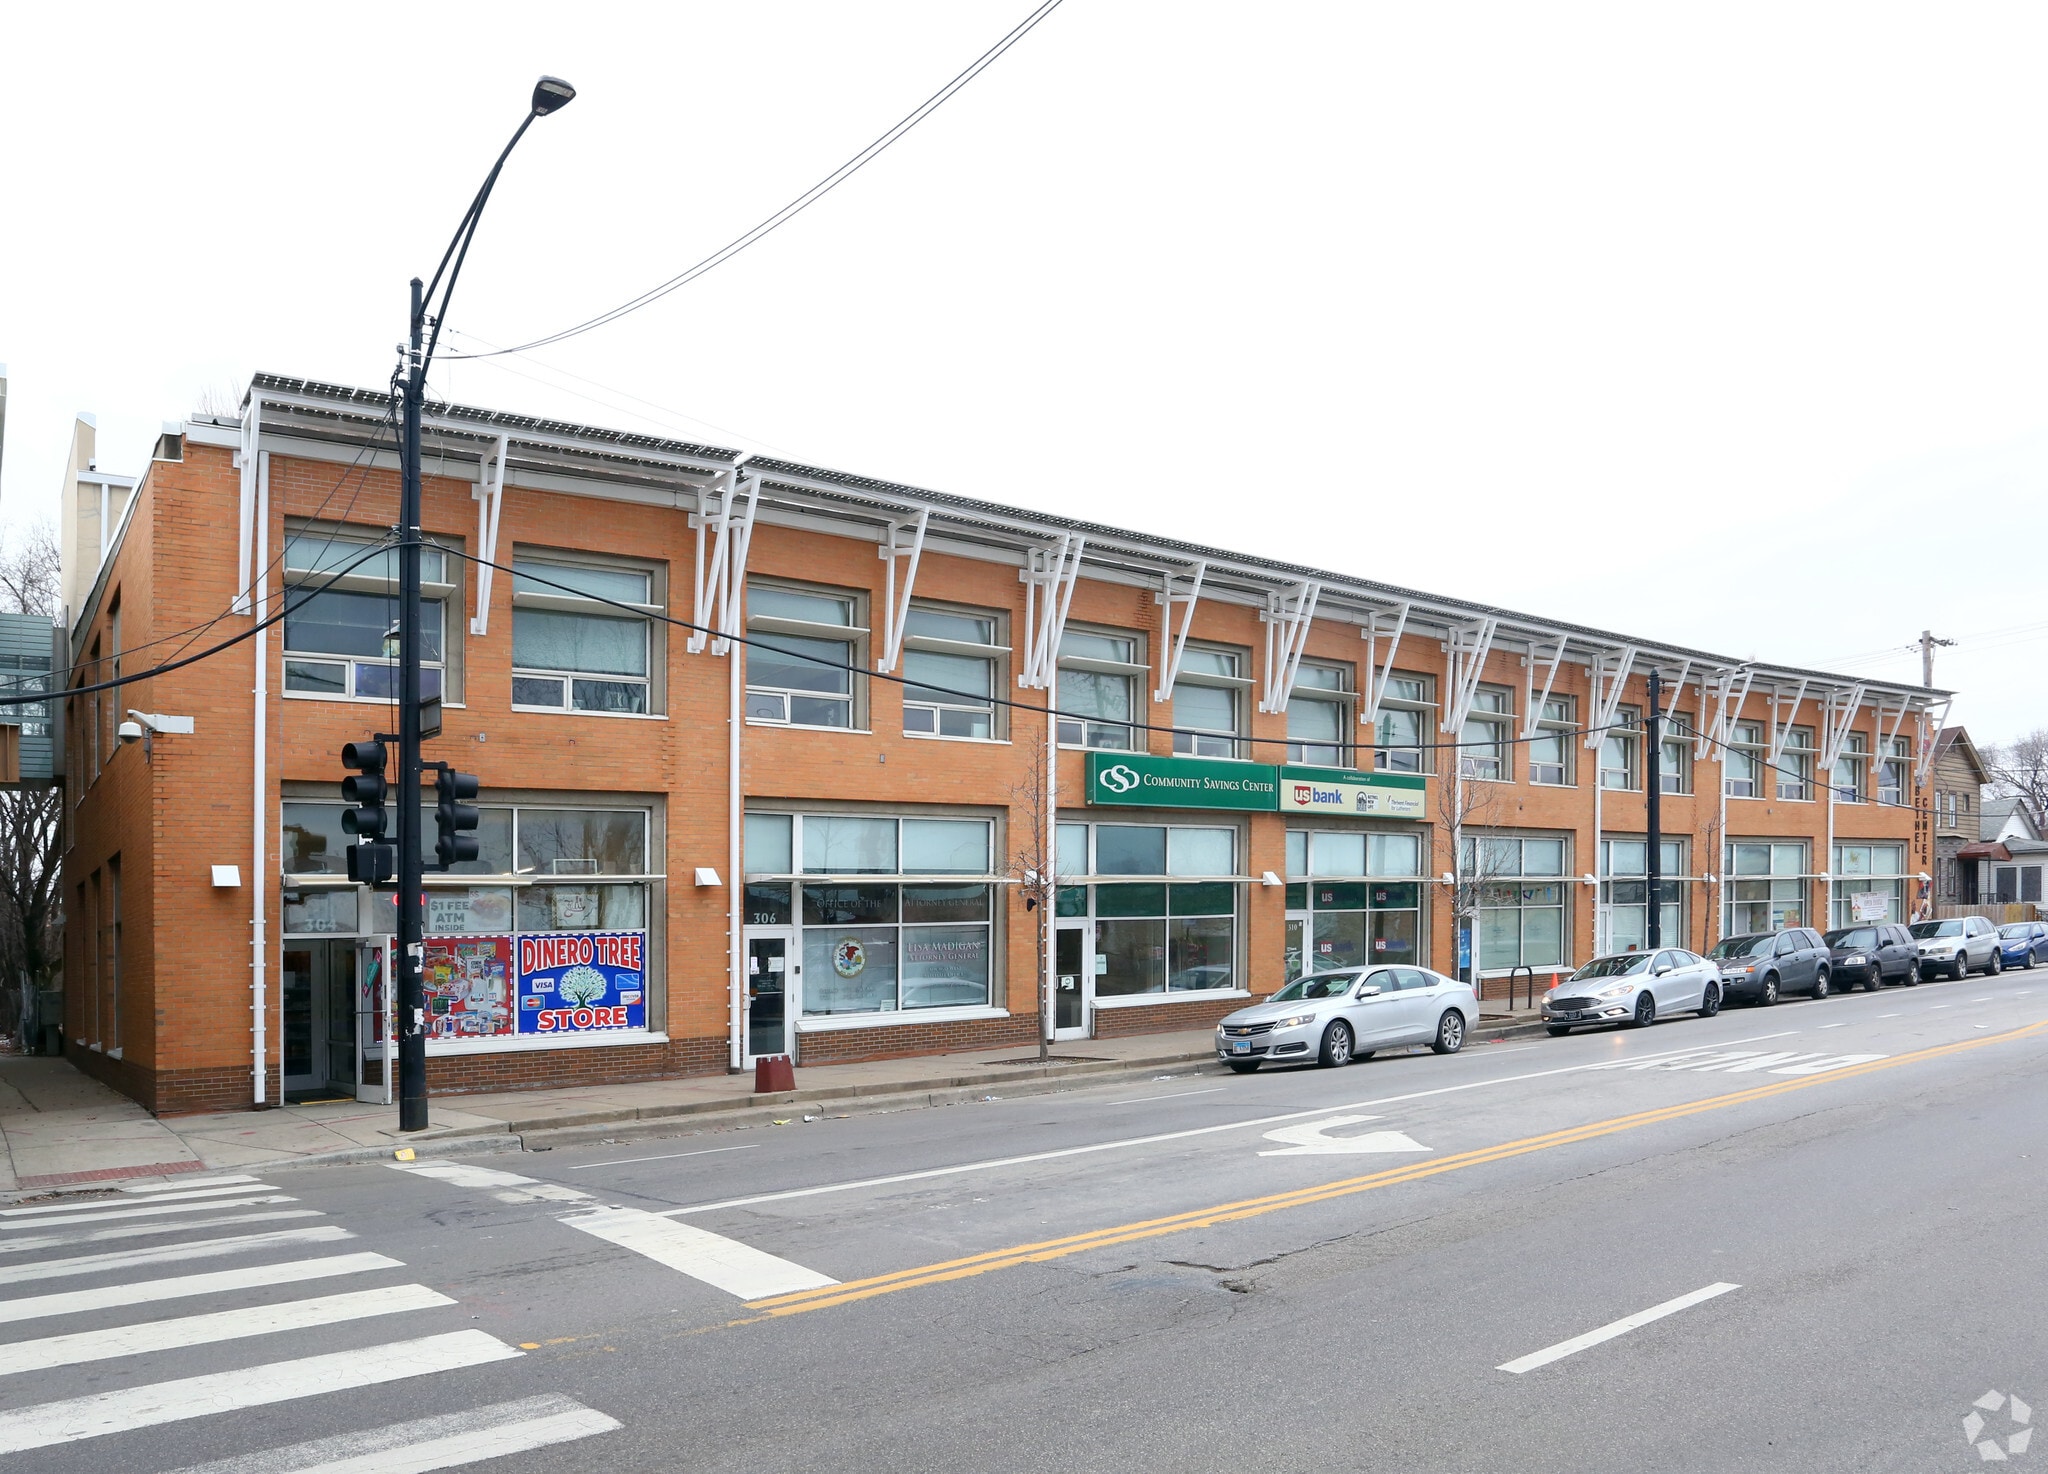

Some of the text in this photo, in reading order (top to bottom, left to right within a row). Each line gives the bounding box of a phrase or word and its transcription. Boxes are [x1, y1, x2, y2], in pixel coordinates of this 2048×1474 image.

[1143, 774, 1274, 793] COMMUNITY SAVINGS CENTER
[1313, 788, 1343, 804] bank
[430, 901, 470, 911] $1 FEE
[436, 913, 465, 922] ATM
[753, 913, 776, 924] 306
[521, 936, 641, 976] DINERO TREE
[537, 1006, 628, 1031] STORE
